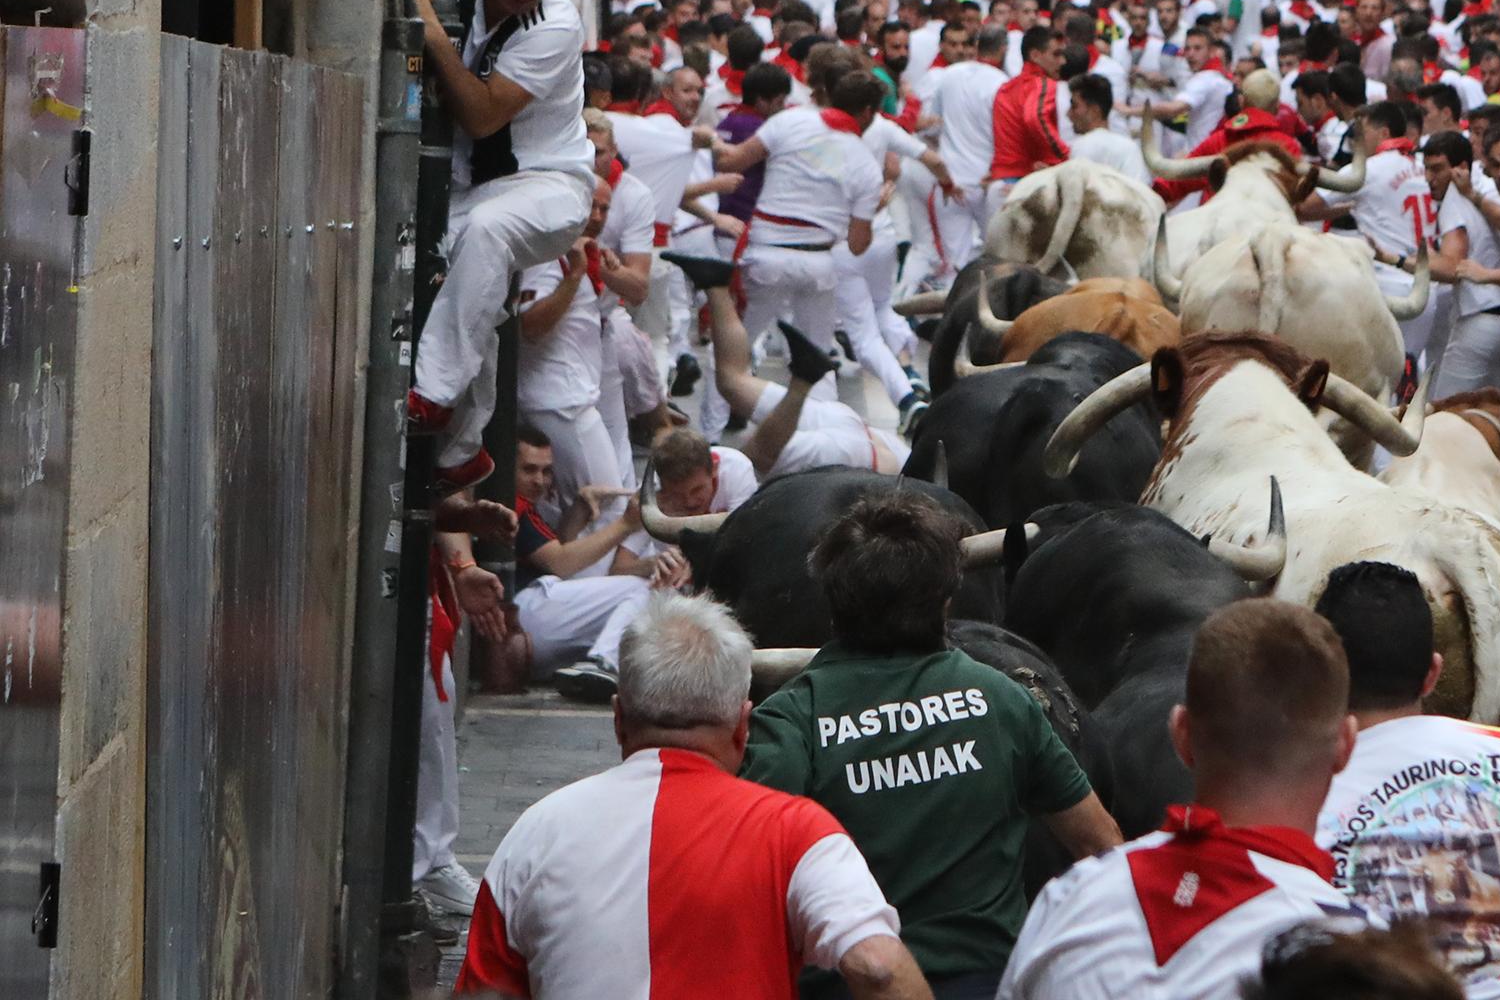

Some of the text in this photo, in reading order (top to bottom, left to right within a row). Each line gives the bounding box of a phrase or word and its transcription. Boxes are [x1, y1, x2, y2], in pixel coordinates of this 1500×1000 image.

[818, 688, 988, 748] PASTORES
[845, 740, 983, 794] UNAIAK
[1370, 758, 1482, 806] TAURINOS
